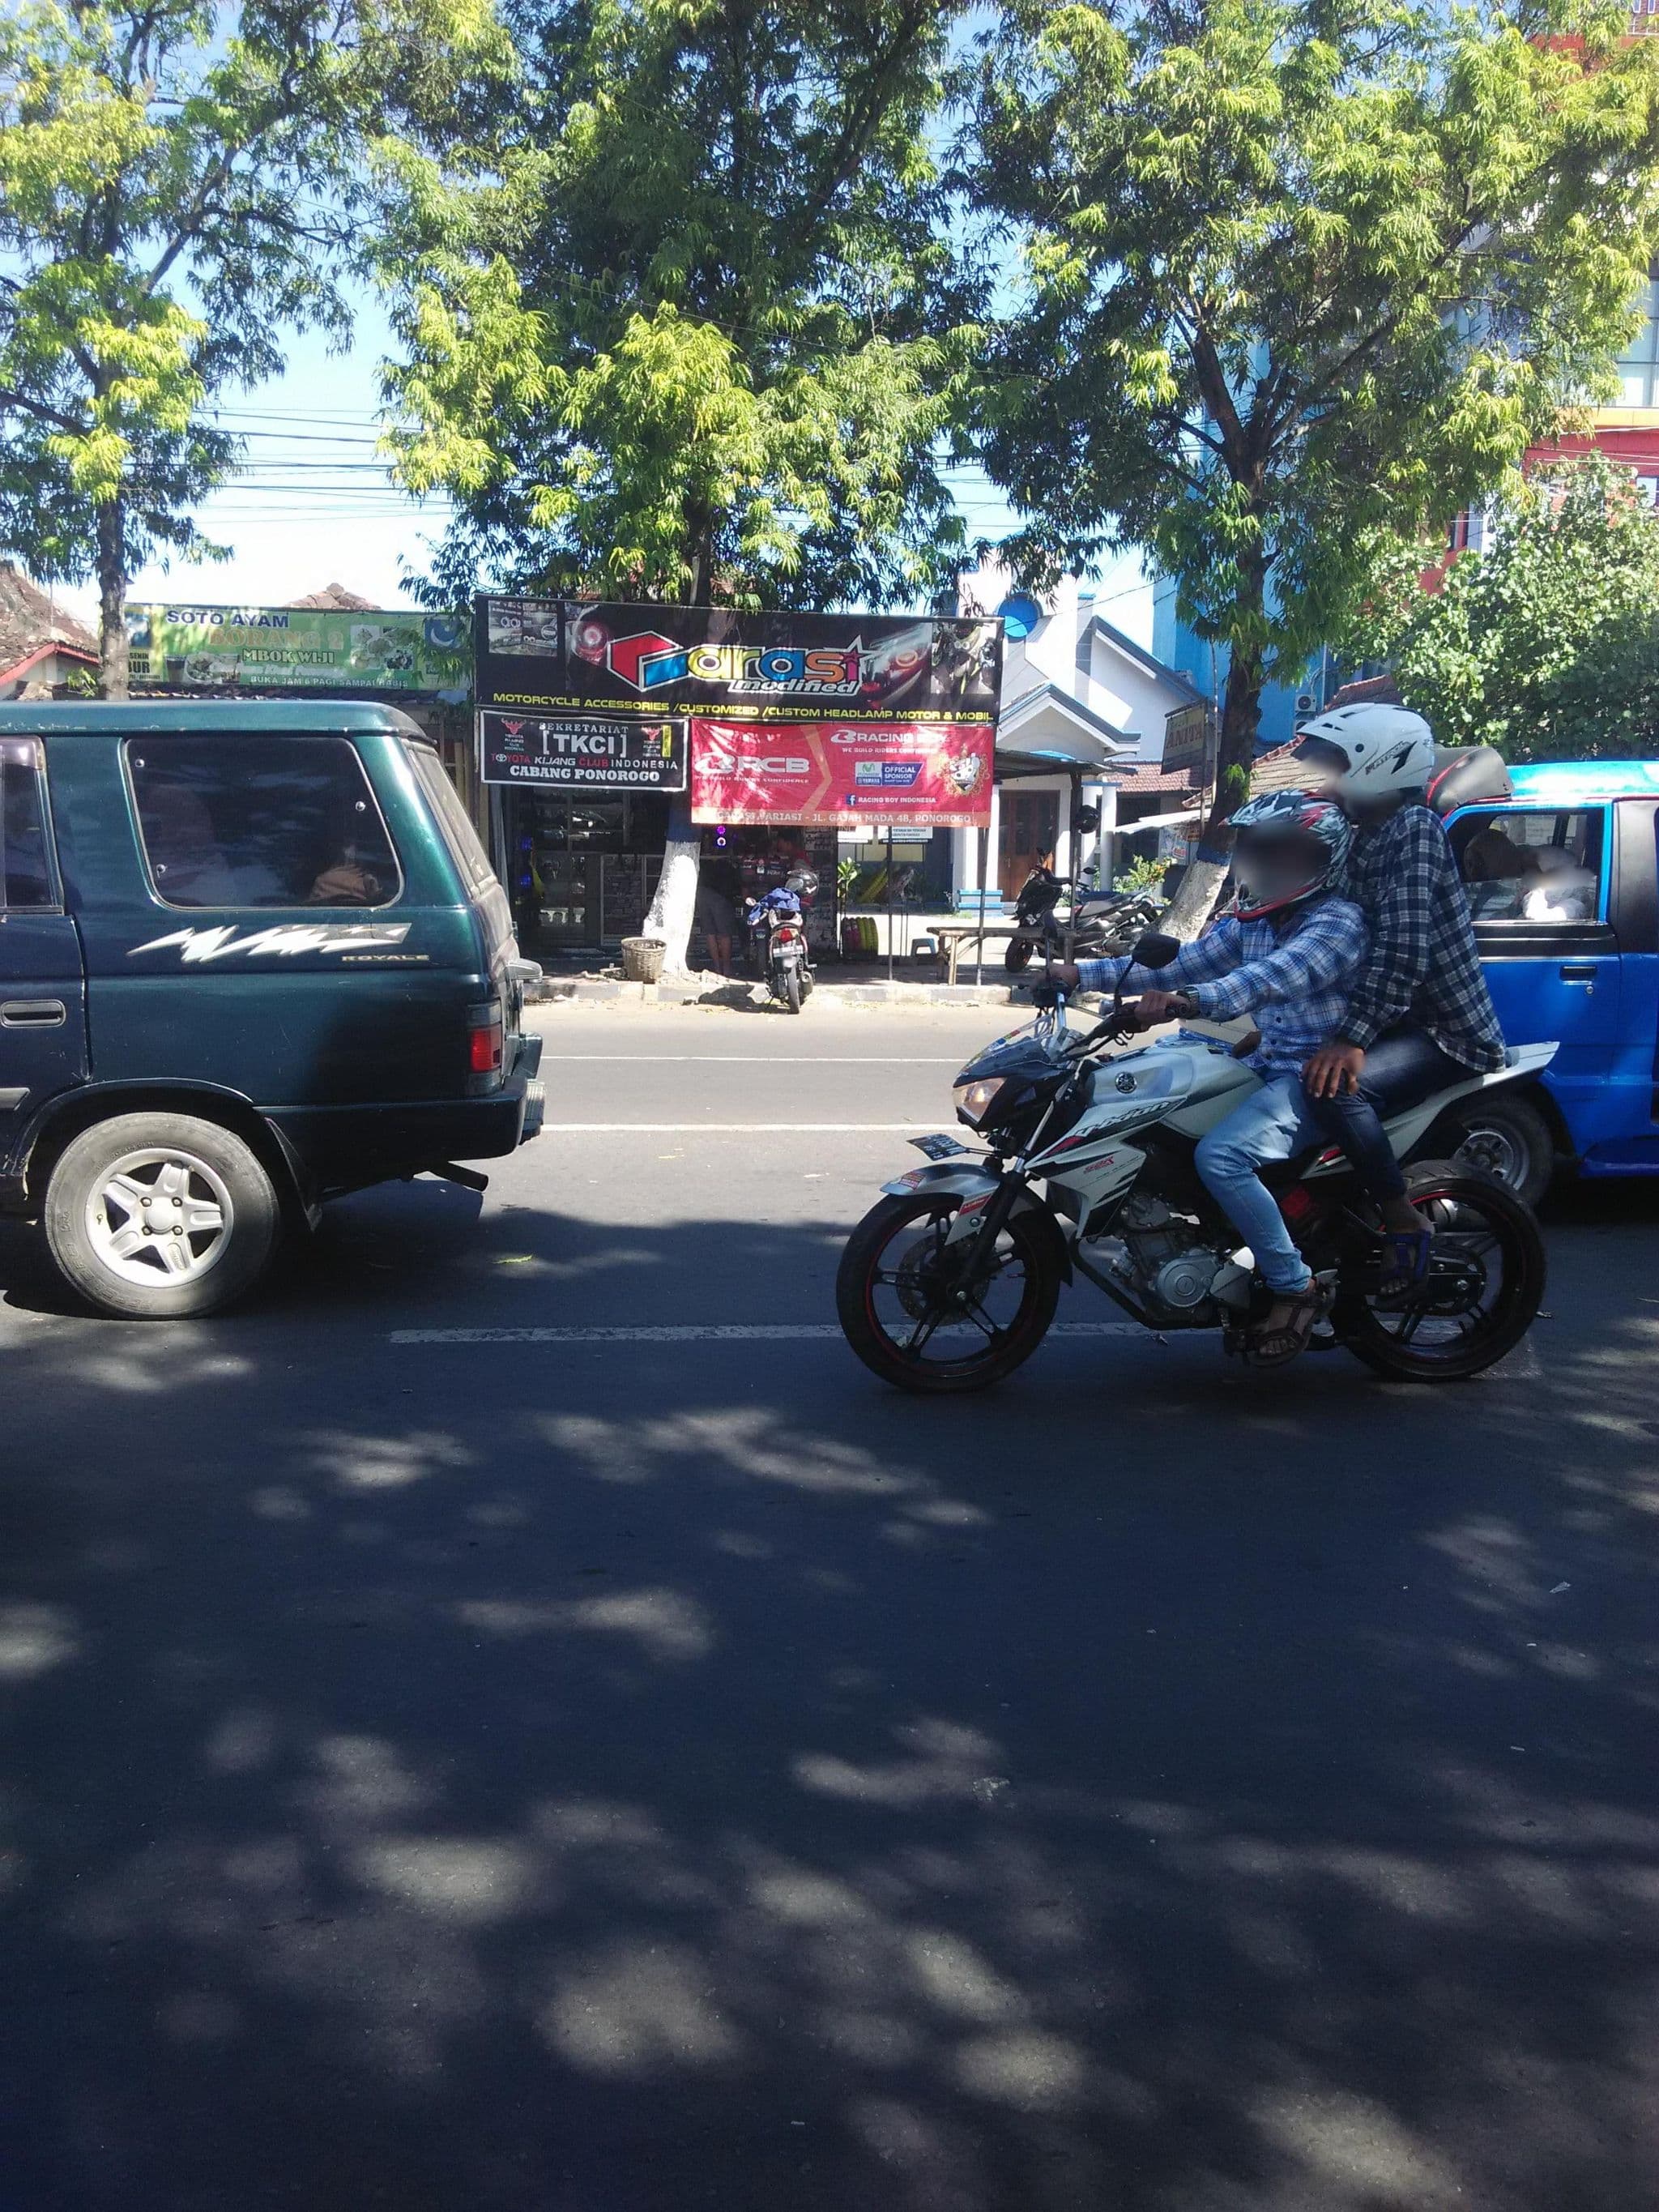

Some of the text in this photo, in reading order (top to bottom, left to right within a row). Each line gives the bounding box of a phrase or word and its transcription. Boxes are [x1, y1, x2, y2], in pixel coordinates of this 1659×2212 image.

[168, 610, 289, 627] SOTO AYAM
[243, 649, 335, 664] MBOK WIJI
[250, 675, 278, 685] BUKA
[281, 677, 301, 685] JAM
[313, 678, 335, 686] PAGI
[732, 678, 857, 694] modified
[493, 693, 580, 707] MOTORCYCLE
[584, 699, 670, 711] ACCESSORIES
[824, 709, 893, 720] HEADLAMP
[896, 711, 940, 720] MOTOR
[956, 711, 993, 720] MOBIL
[539, 723, 629, 734] SEKRETARIAT
[857, 732, 914, 744] RACING
[535, 757, 576, 766] KIJANG
[578, 758, 609, 767] CLUB
[611, 759, 678, 770] INDONESIA
[738, 756, 809, 773] RCB
[510, 765, 660, 782] CABANG PONOROGO
[812, 813, 826, 822] JL.
[829, 813, 862, 822] GAJAH
[865, 814, 893, 822] MADA
[915, 814, 971, 822] PONOROGO
